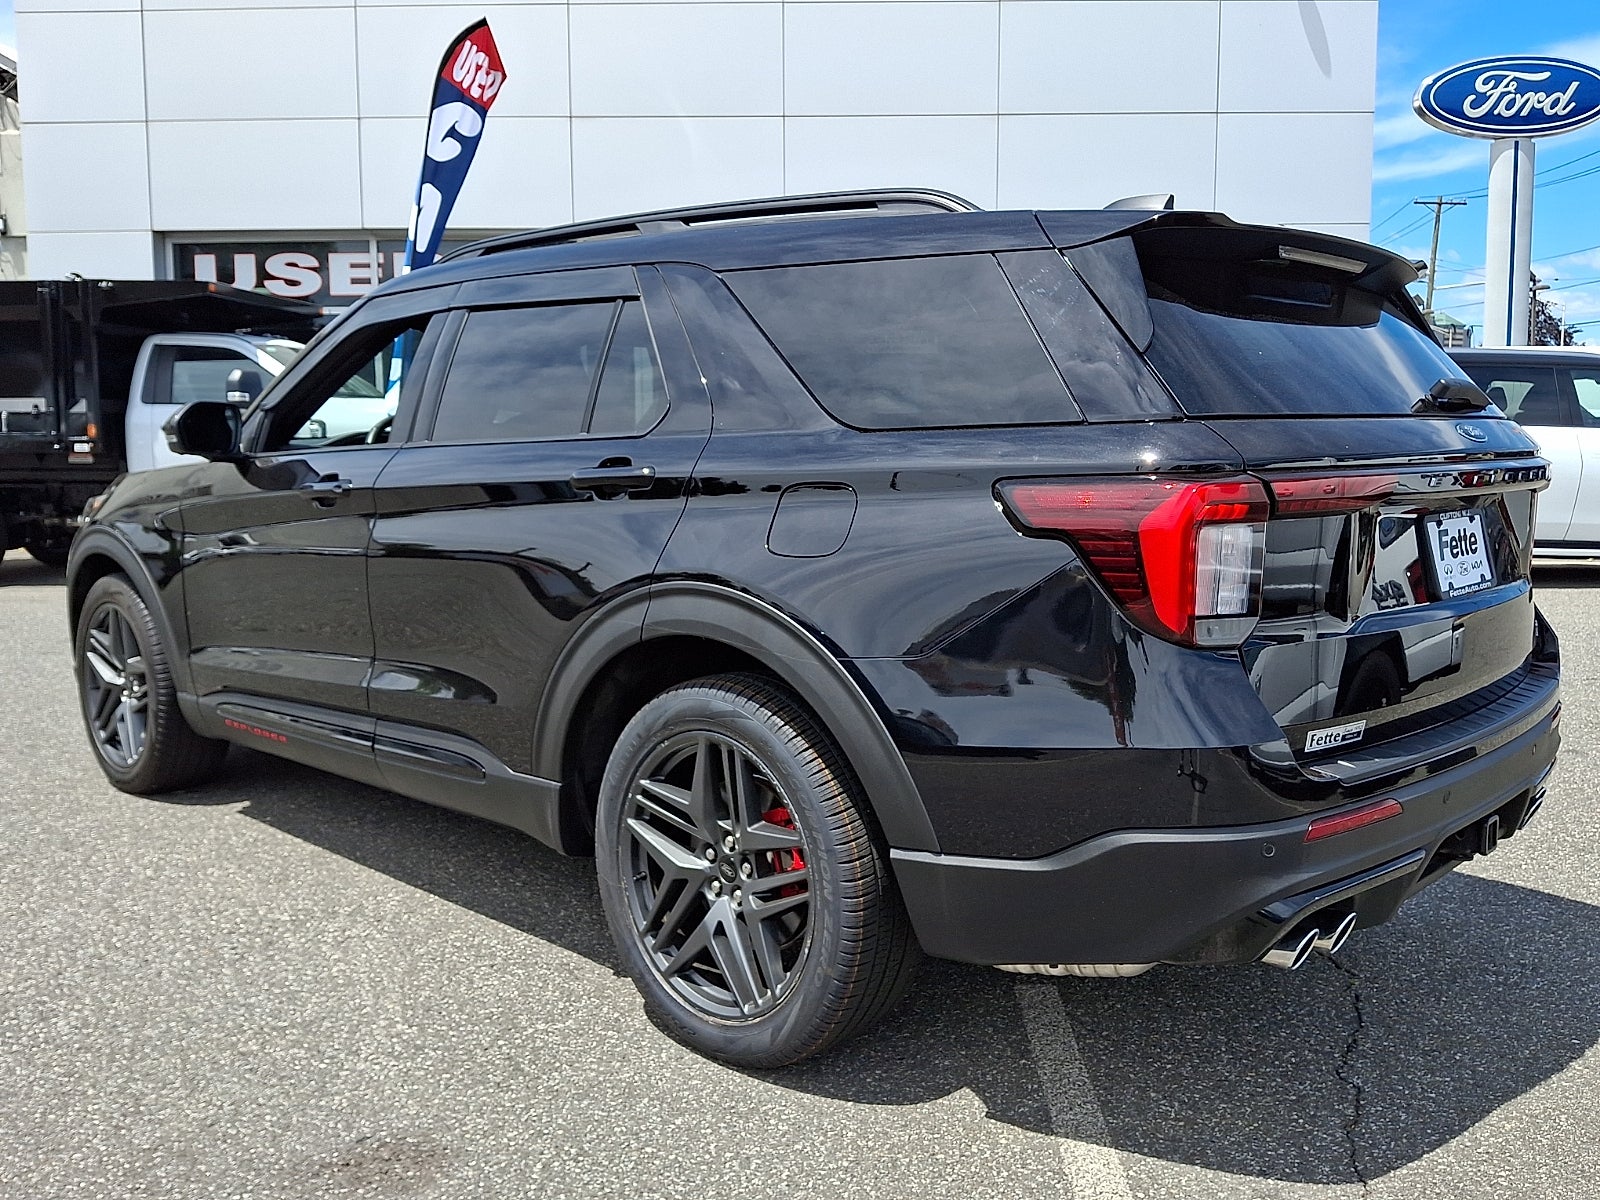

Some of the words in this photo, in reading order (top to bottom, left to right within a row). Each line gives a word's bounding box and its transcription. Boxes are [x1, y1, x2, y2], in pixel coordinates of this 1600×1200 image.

[1463, 70, 1580, 118] Ford
[194, 252, 442, 298] USE
[1437, 527, 1479, 561] Fette
[1449, 581, 1492, 598] FetteAuto.com
[1309, 732, 1341, 748] Fette
